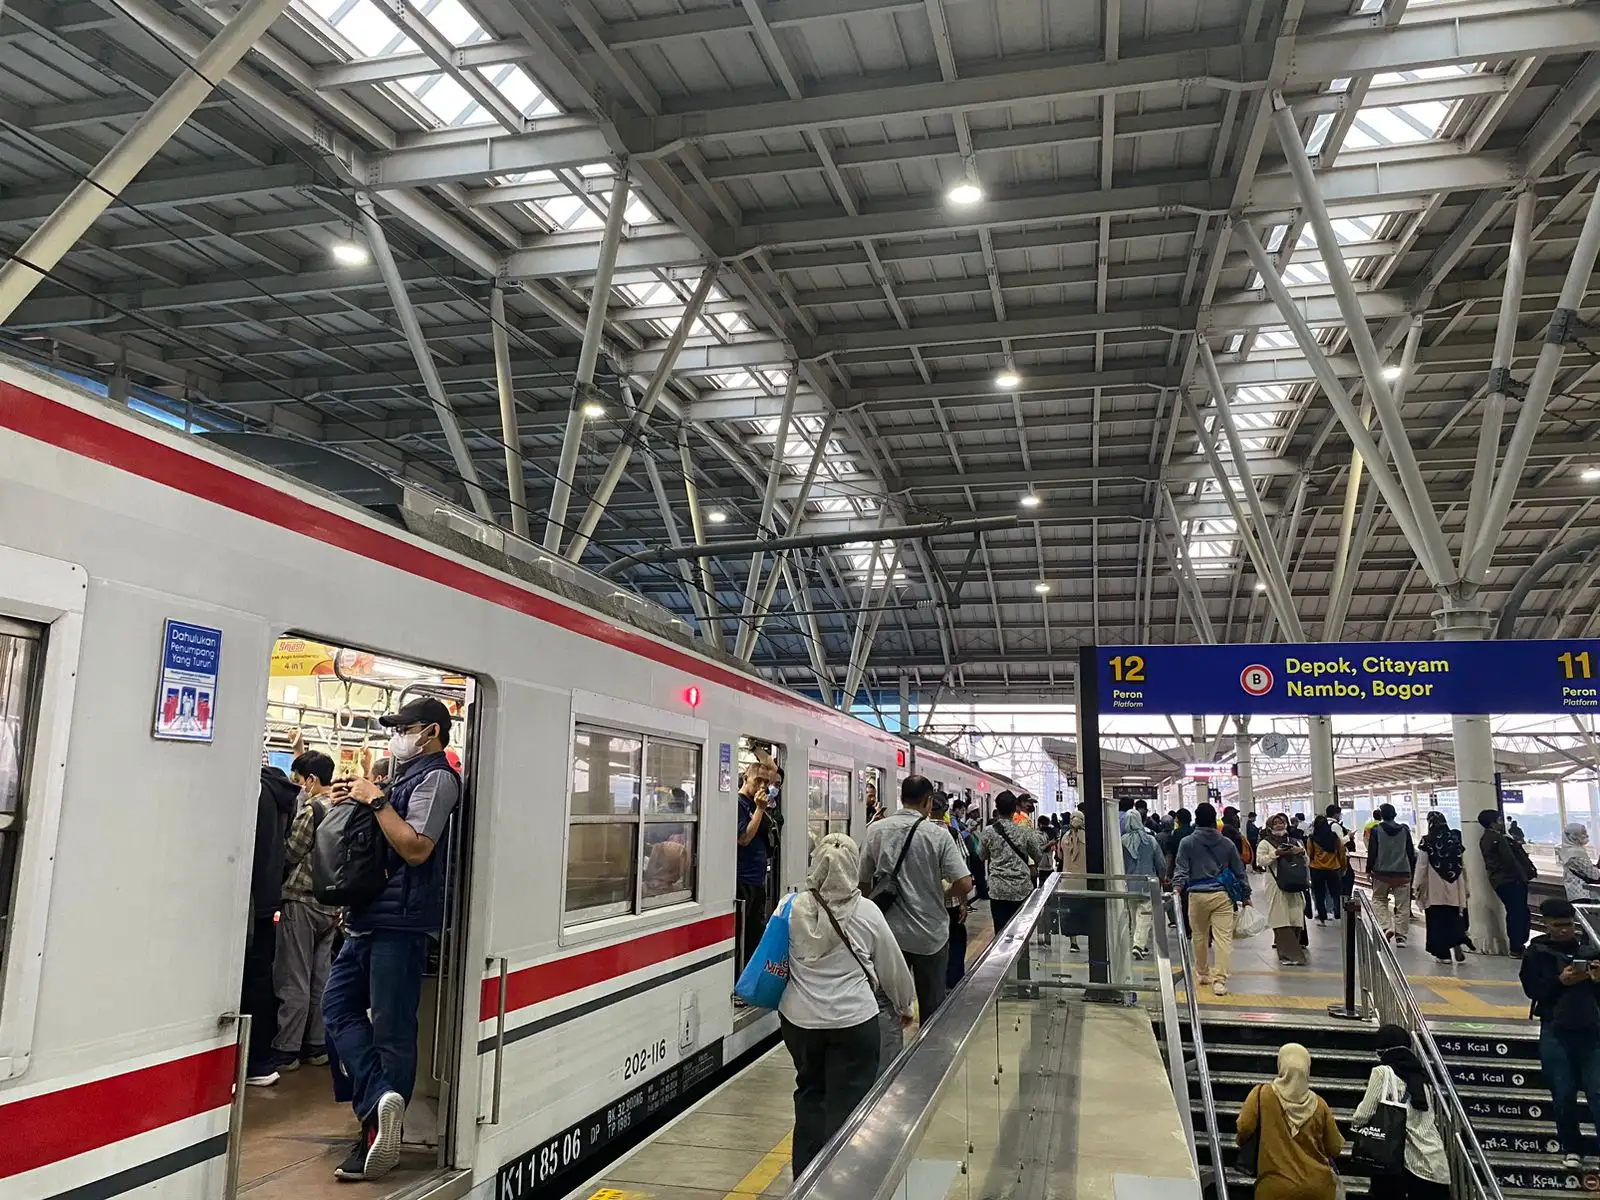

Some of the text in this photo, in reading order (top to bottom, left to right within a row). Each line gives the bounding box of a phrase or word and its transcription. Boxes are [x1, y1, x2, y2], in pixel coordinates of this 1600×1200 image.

[171, 629, 216, 647] Dahulukan
[170, 642, 215, 661] Penumpang
[171, 653, 212, 668] Yang Turun
[1109, 655, 1145, 681] 12
[1285, 656, 1449, 677] Depok, Citayam
[1557, 651, 1591, 679] 11
[1253, 673, 1262, 685] B
[1113, 689, 1143, 699] Peron
[1287, 680, 1433, 700] Nambo, Bogor
[1562, 686, 1597, 696] Peron
[1112, 700, 1143, 708] Platform
[1562, 698, 1598, 706] Platform
[1441, 1042, 1489, 1052] -4,5 Kcal
[624, 1038, 666, 1081] 202-116
[1455, 1072, 1504, 1083] -4,4 Kcal
[1469, 1103, 1521, 1114] -4,3 Kcal
[590, 1123, 600, 1145] DP
[607, 1122, 616, 1139] TP
[540, 1140, 559, 1181] 85
[563, 1127, 581, 1166] 06
